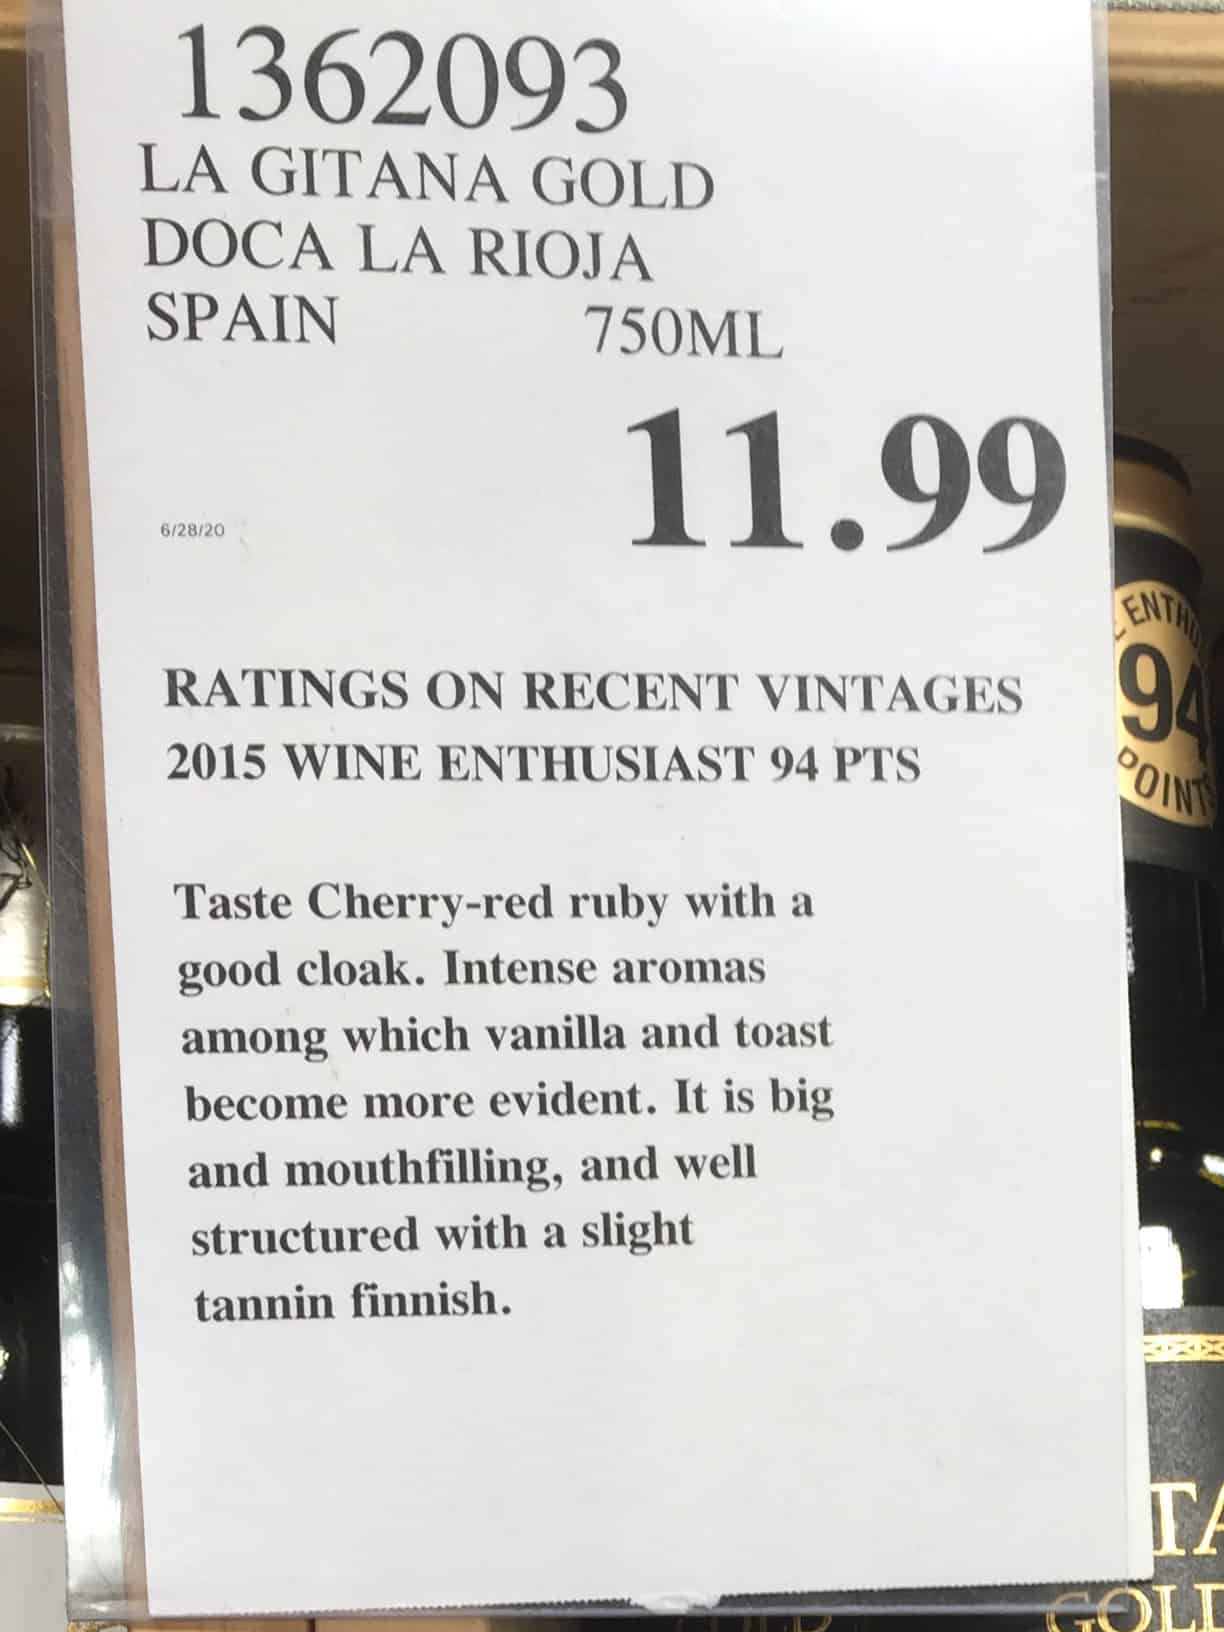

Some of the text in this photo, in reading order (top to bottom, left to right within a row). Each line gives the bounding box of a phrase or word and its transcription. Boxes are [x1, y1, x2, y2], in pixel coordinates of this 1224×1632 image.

[178, 23, 628, 134] 1362093
[139, 143, 715, 210] LA GITANA GOLD
[143, 217, 653, 283] DOCA LA RIOJA
[146, 291, 784, 360] SPAIN 750ML
[627, 407, 1067, 553] 11.99
[160, 522, 225, 538] 6/28/20
[165, 667, 1024, 716] RATINGS ON RECENT VINTAGES
[1118, 642, 1209, 768] 94
[167, 743, 922, 783] 2015 WINE ENTHUSIAST 94 PTS
[173, 882, 814, 929] Taste Cherry-red ruby with a
[178, 950, 767, 997] good cloak. Intense aromas
[181, 1013, 834, 1063] among which vanilla and toast
[184, 1077, 836, 1122] become more evident. It is big
[188, 1143, 757, 1193] and mouthfilling, and well
[191, 1210, 694, 1257] structured with a slight
[194, 1280, 512, 1323] tannin finnish.
